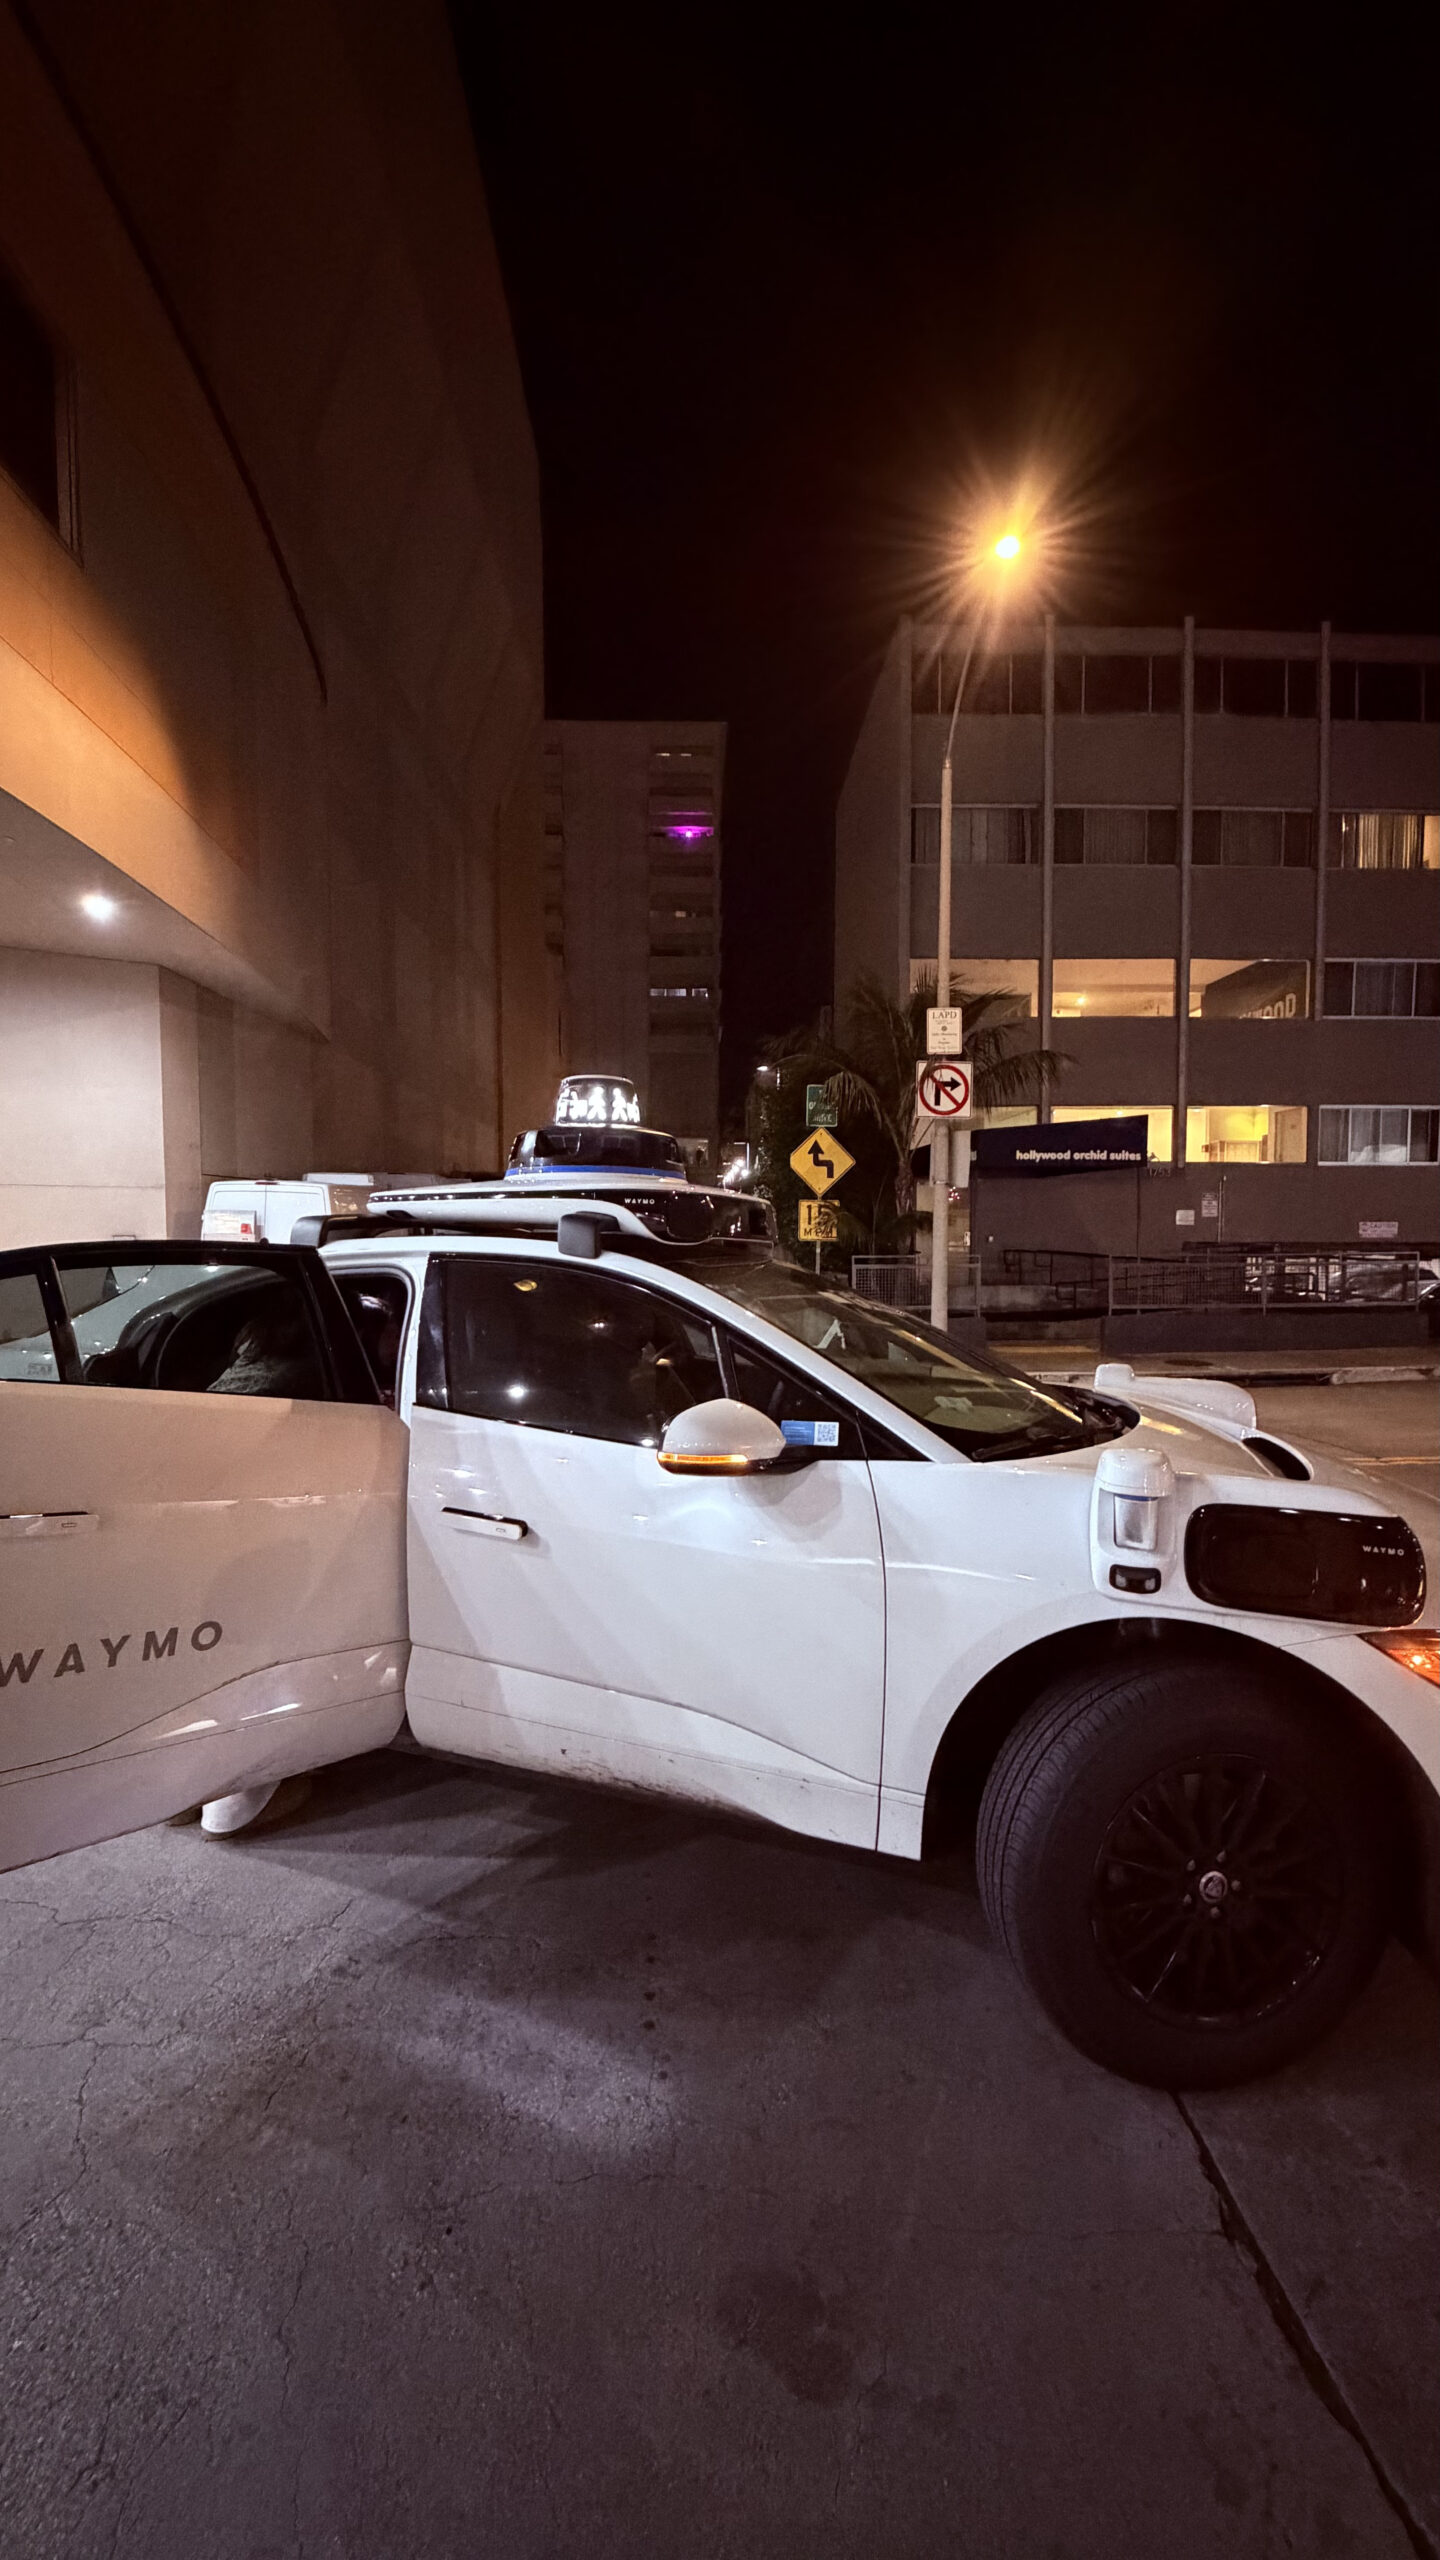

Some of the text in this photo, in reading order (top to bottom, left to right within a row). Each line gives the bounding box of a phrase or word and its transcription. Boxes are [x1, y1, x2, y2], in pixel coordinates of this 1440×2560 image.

[932, 1011, 957, 1019] LAPD
[1016, 1150, 1141, 1163] hollywood orchid suites
[1362, 1545, 1405, 1556] WAYMO
[0, 1620, 223, 1687] WAYMO
